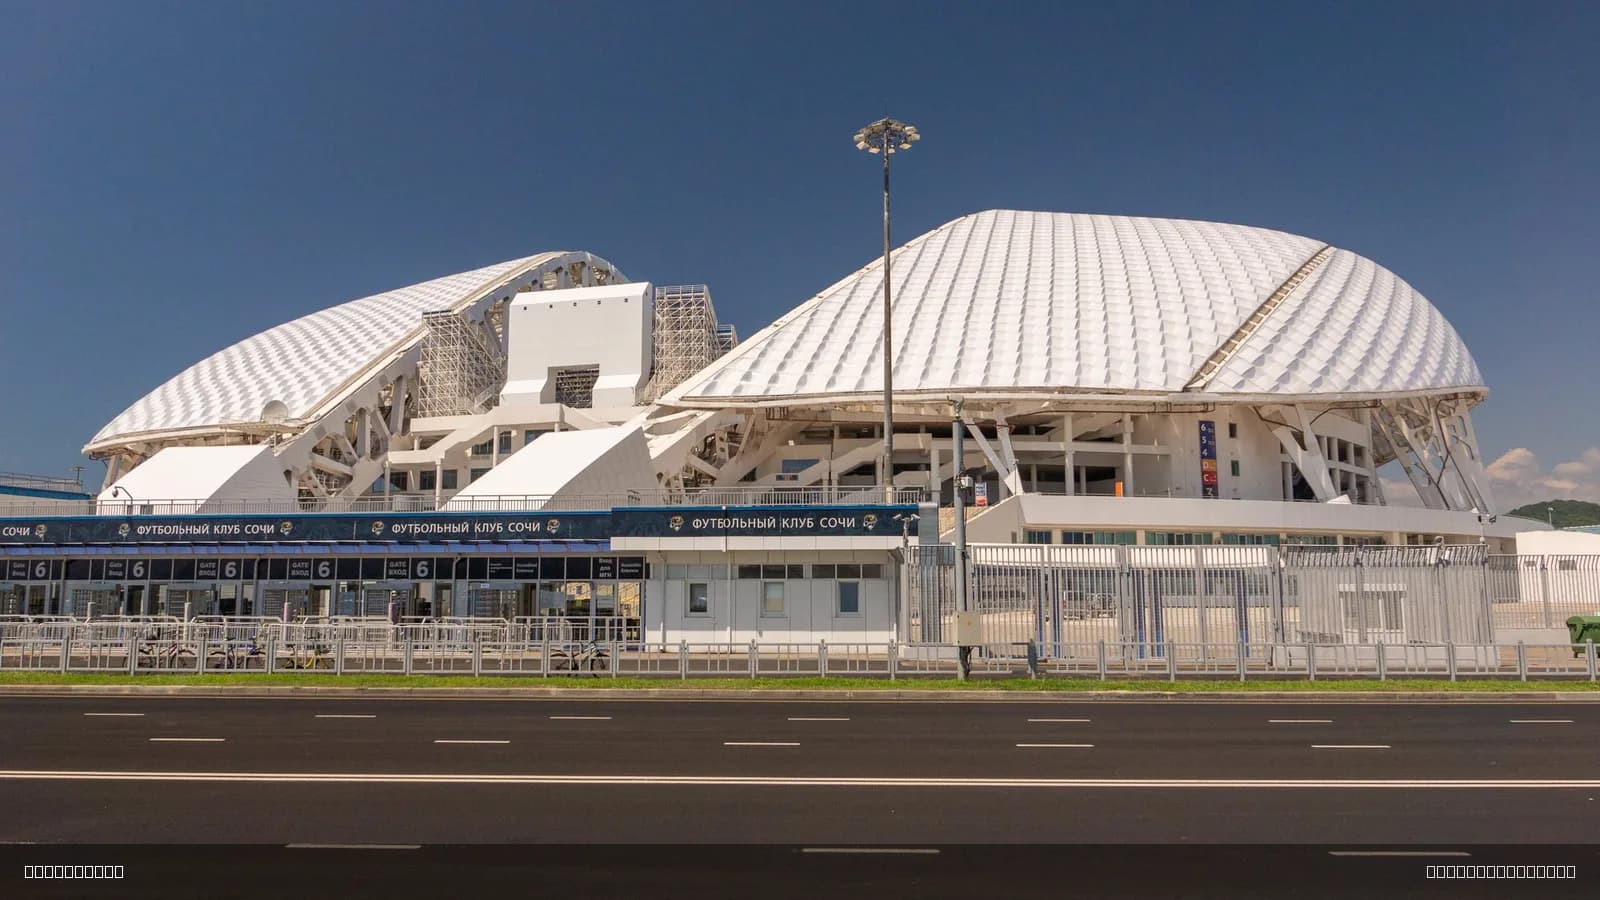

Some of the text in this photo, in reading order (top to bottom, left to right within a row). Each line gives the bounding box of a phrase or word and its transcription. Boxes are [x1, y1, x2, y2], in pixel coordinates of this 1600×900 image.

[1202, 436, 1207, 444] 5
[1203, 461, 1208, 469] D
[391, 522, 541, 535] ФУТБОЛЬНЫЙ КЛУБ СОЧИ
[692, 516, 856, 529] ФУТБОЛЬНЫЙ КЛУБ СОЧИ
[2, 526, 30, 537] СОЧИ
[136, 523, 275, 536] ФУТБОЛЬНЫЙ КЛУБ СОЧИ
[35, 562, 46, 578] 6
[133, 561, 145, 577] 6
[225, 561, 237, 577] 6
[318, 561, 330, 577] 6
[416, 561, 429, 577] 6
